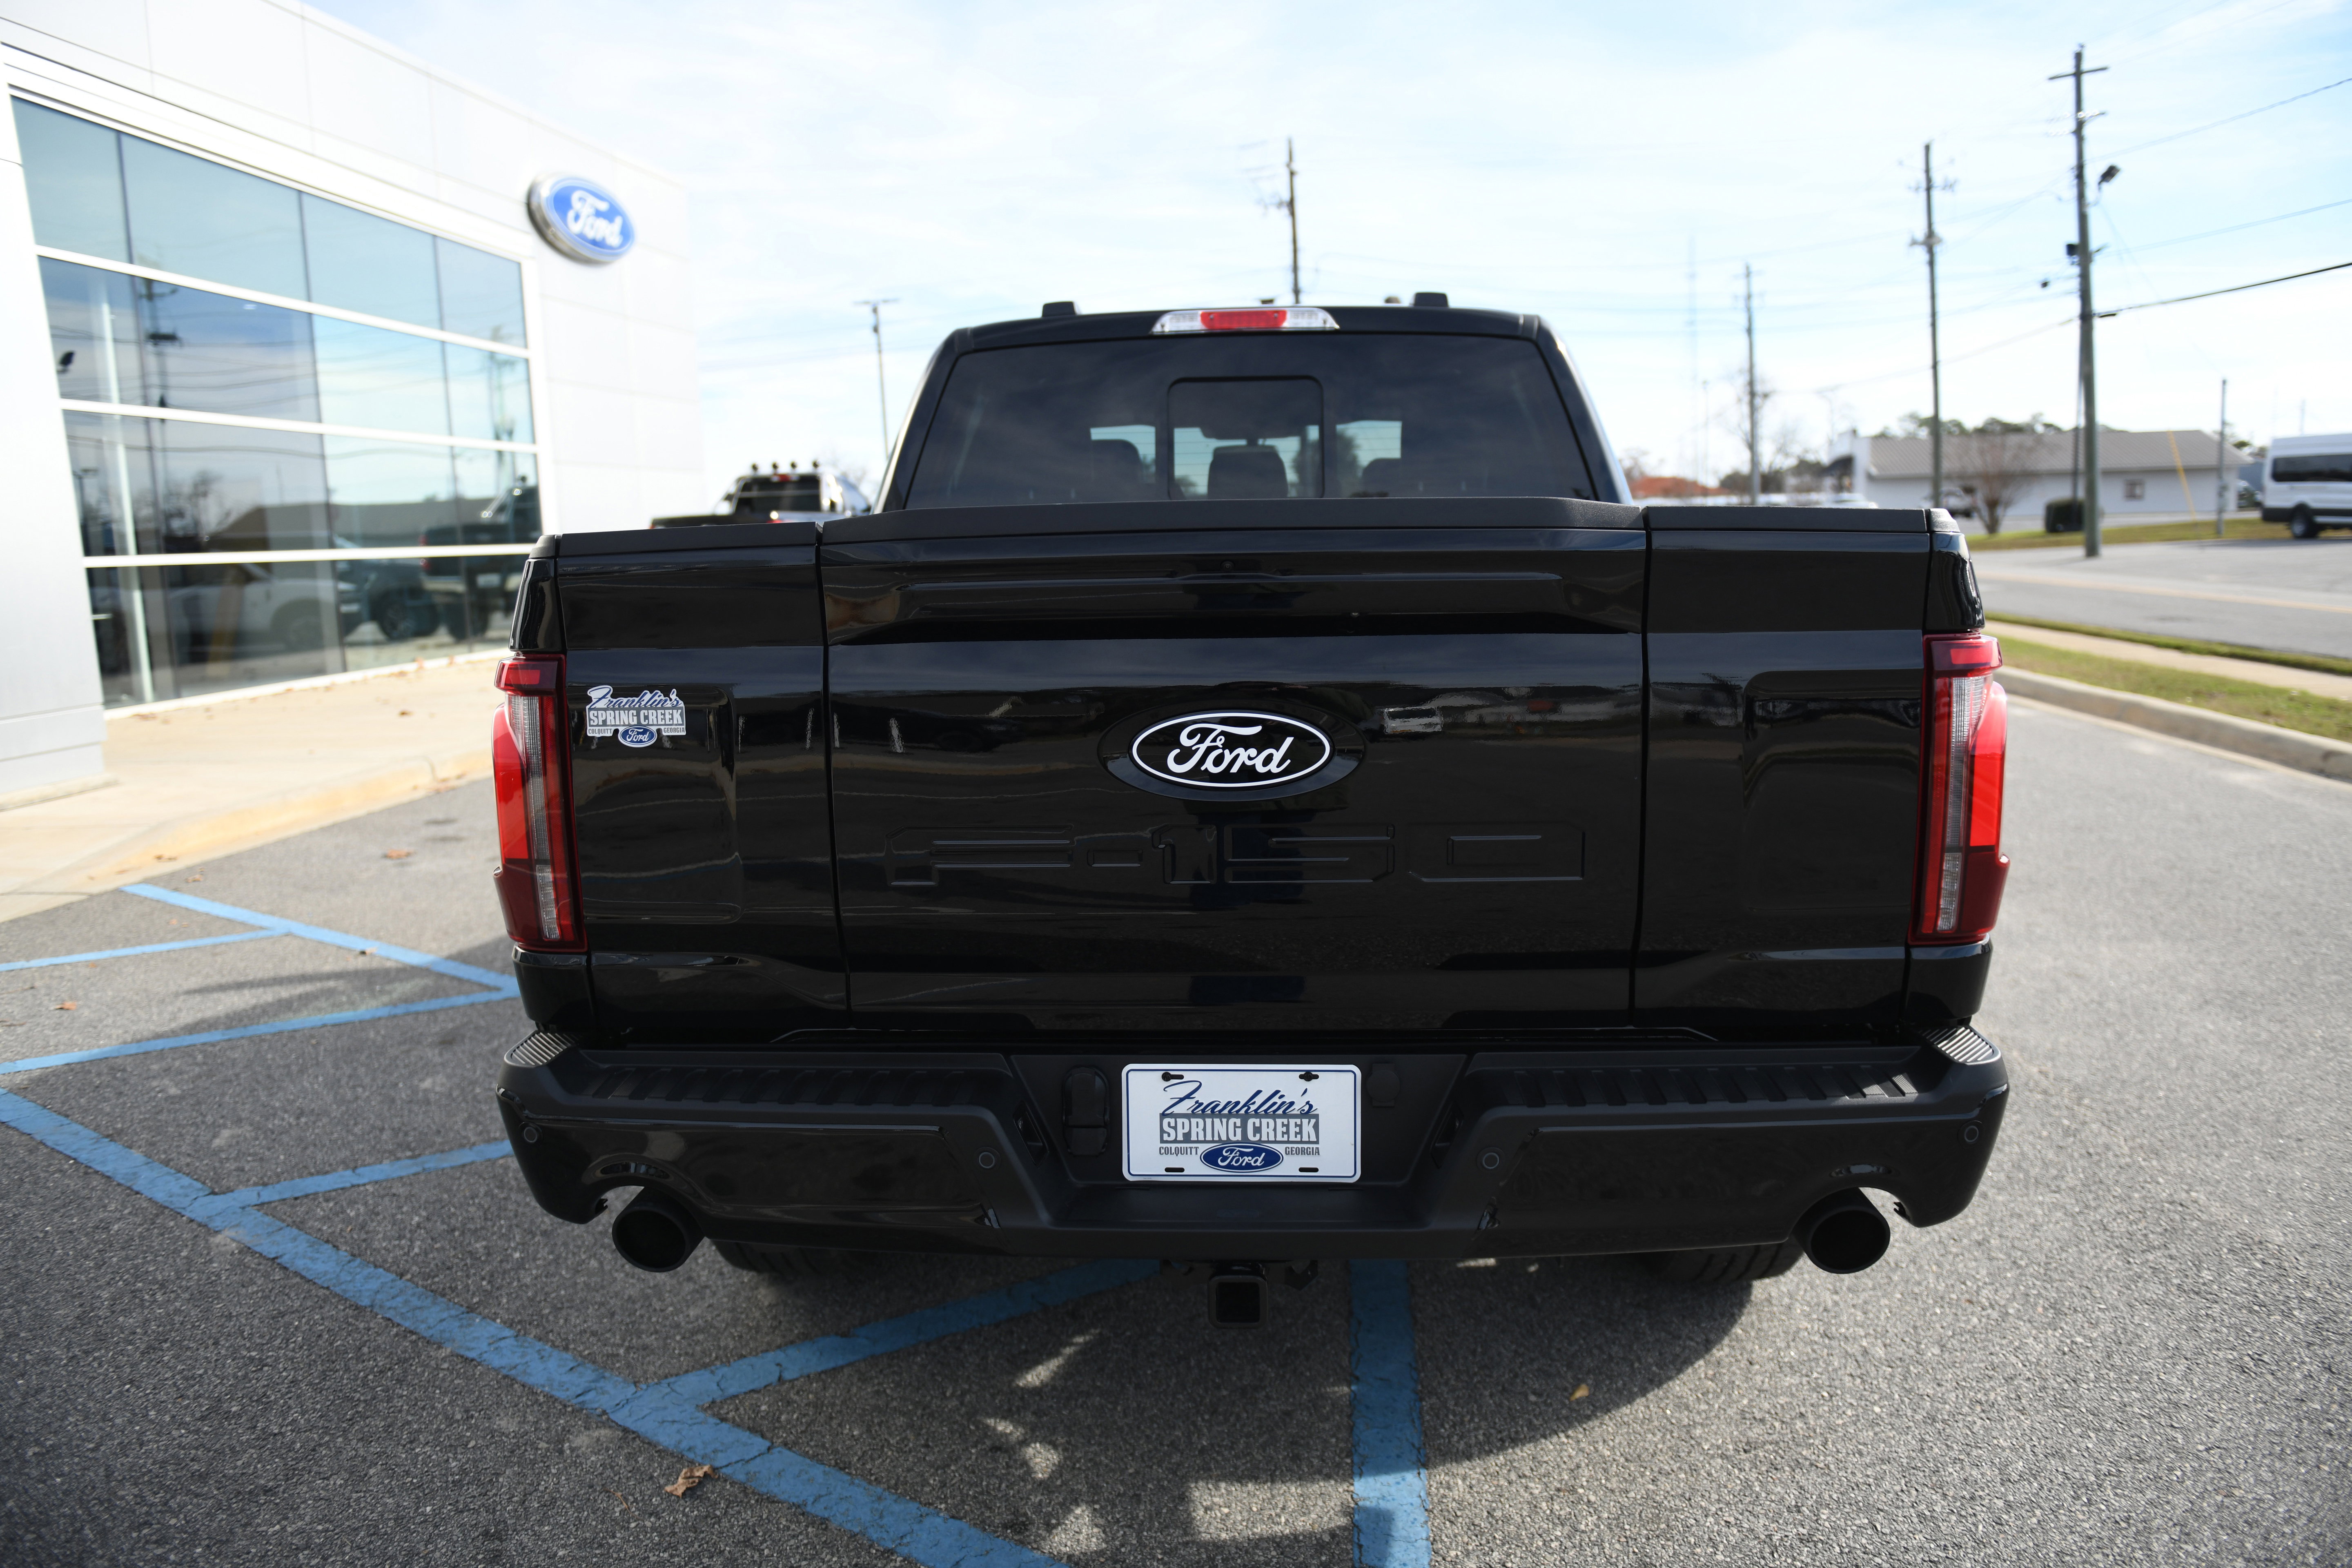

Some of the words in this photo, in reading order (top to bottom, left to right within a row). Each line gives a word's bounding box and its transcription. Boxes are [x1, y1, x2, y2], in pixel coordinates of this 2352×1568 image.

[567, 190, 624, 247] Ford
[589, 687, 682, 709] Franklin's
[590, 710, 637, 725] SPRING
[640, 710, 682, 725] CREEK
[627, 728, 648, 742] Ford
[1167, 723, 1294, 773] Ford
[885, 822, 1585, 886] F-150
[1162, 1080, 1318, 1116] Franklin's
[1163, 1118, 1242, 1141] SPRING
[1247, 1118, 1316, 1142] CREEK
[1159, 1147, 1199, 1156] COLQUITT
[1218, 1147, 1265, 1167] Ford
[1285, 1147, 1320, 1156] GEORGIA
